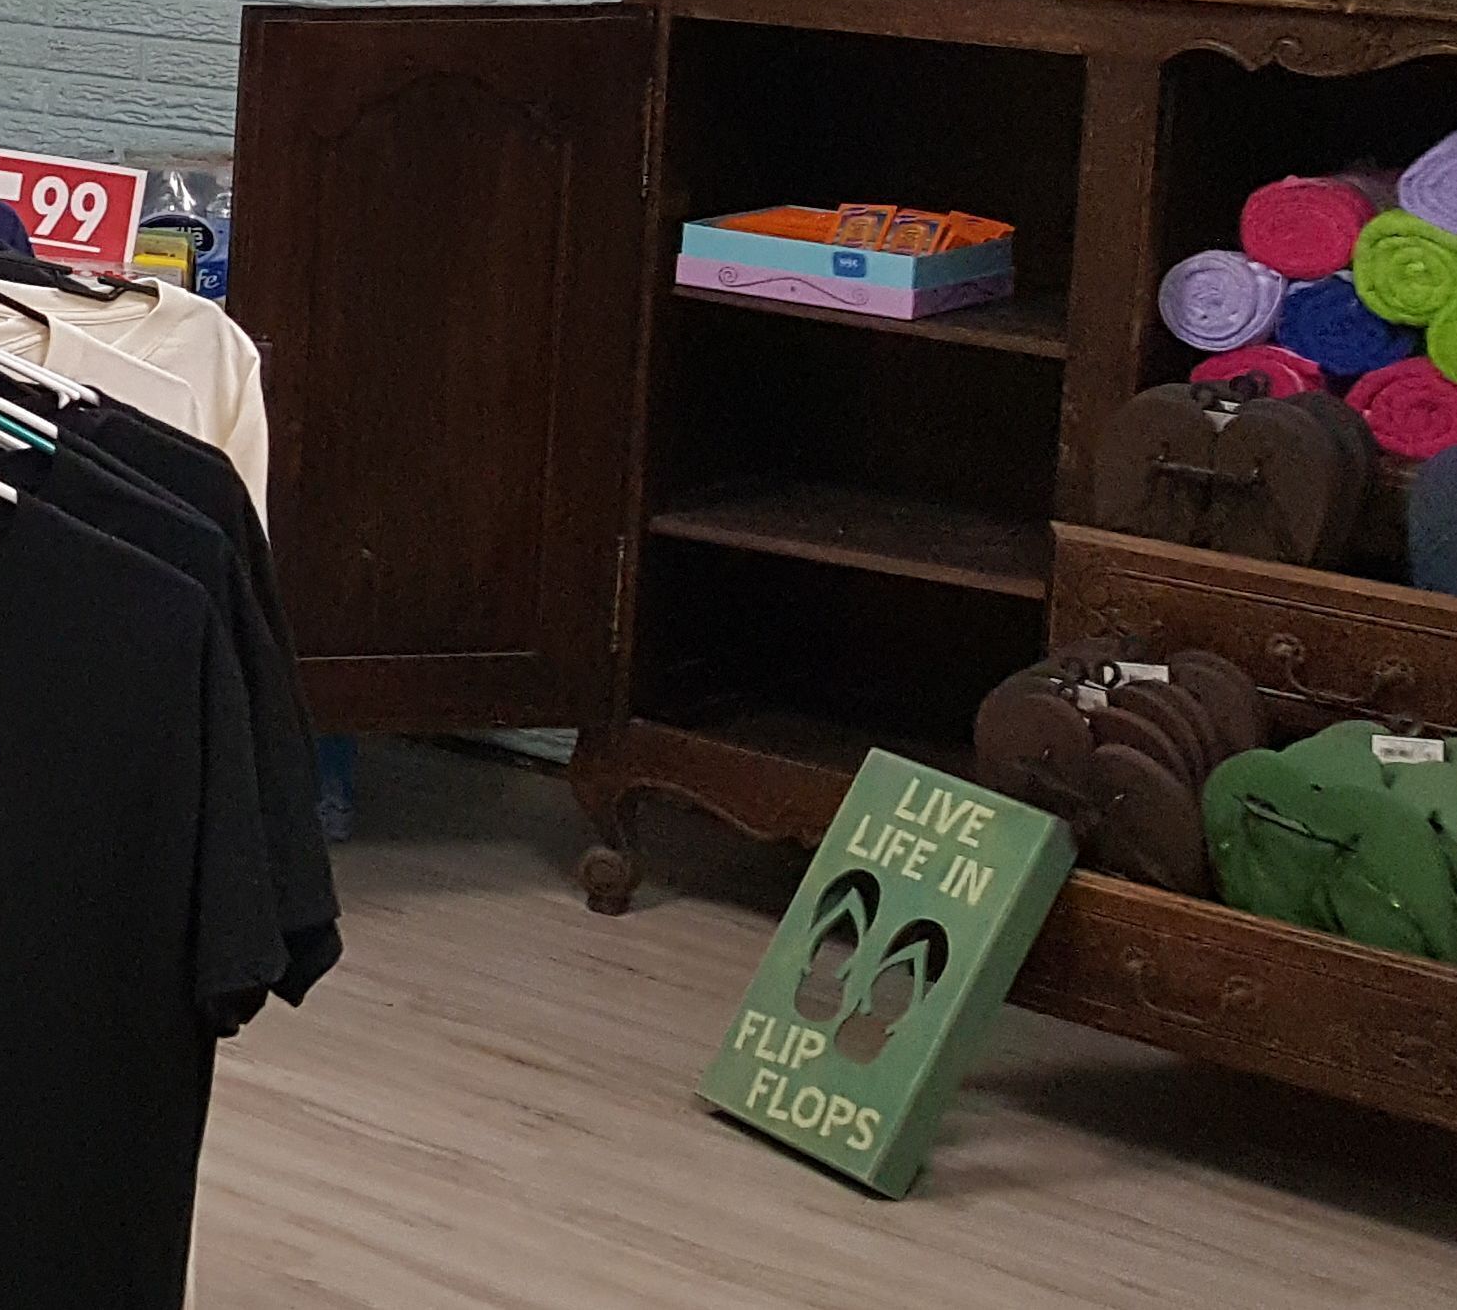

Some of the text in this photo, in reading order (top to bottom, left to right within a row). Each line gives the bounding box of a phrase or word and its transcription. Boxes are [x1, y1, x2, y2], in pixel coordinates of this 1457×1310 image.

[894, 777, 996, 849] LIVE
[846, 814, 994, 906] LIFE IN
[733, 1009, 826, 1070] FLIP
[745, 1067, 881, 1152] FLOPS
